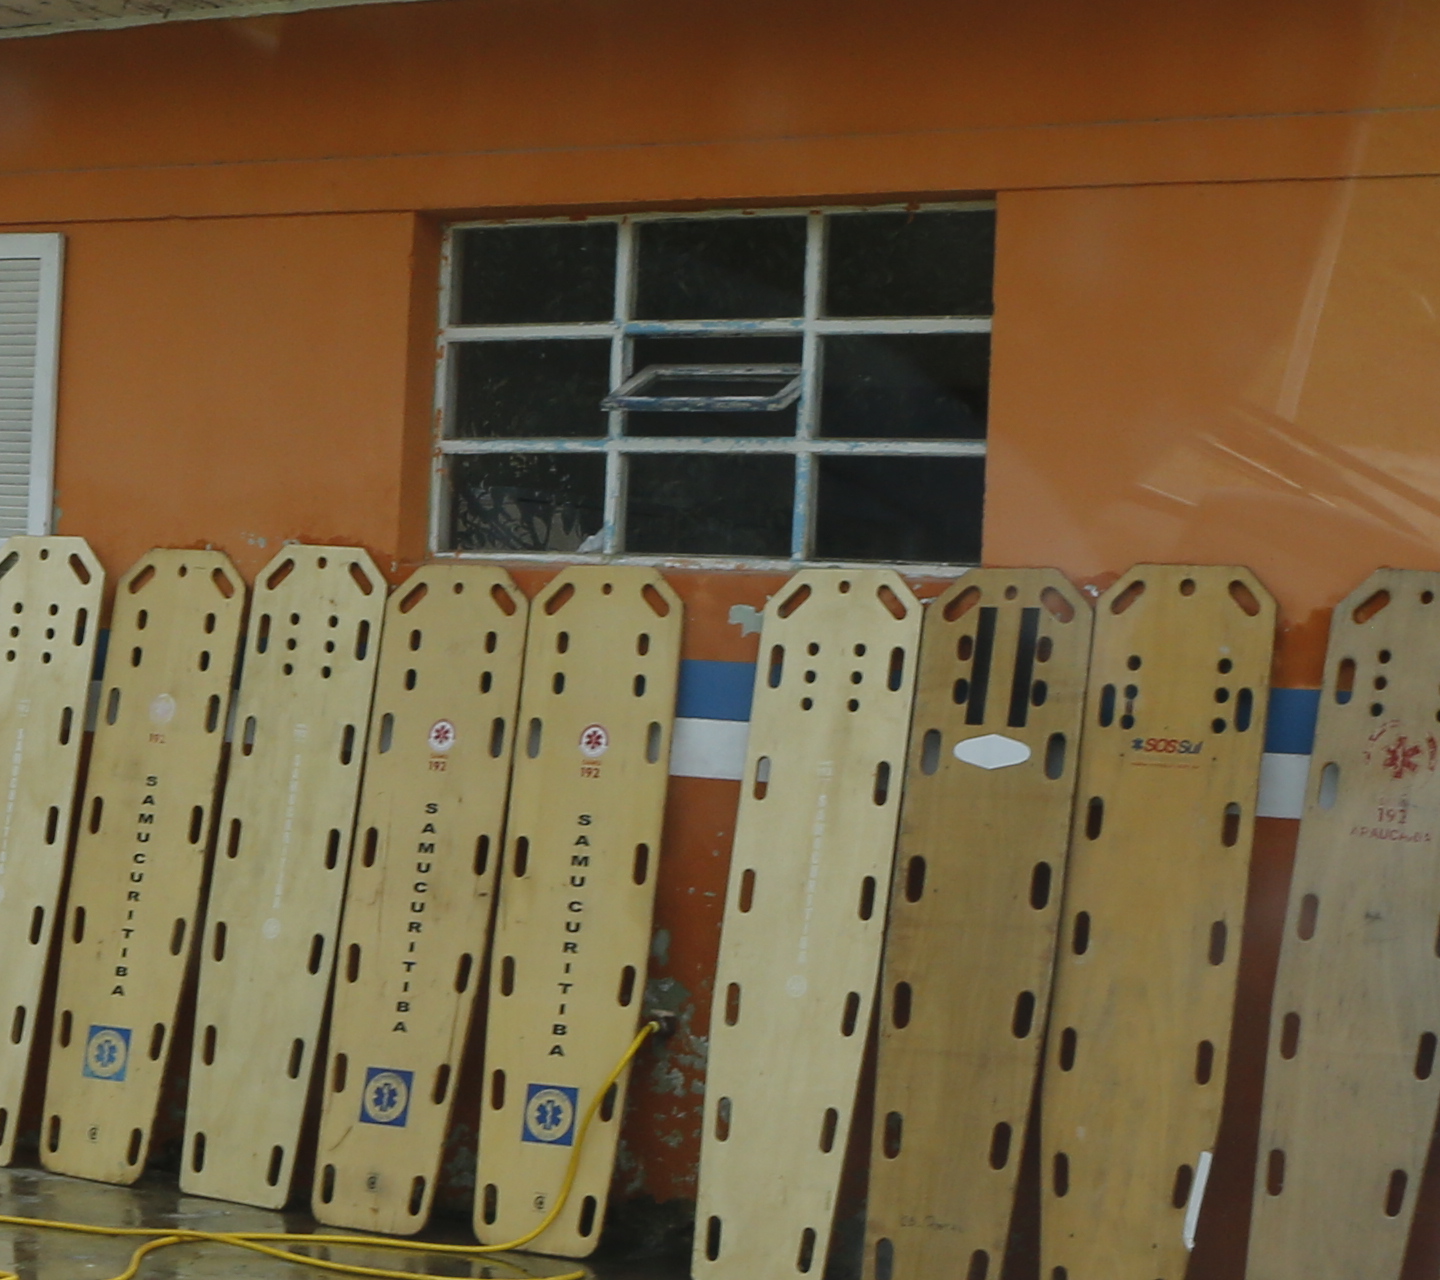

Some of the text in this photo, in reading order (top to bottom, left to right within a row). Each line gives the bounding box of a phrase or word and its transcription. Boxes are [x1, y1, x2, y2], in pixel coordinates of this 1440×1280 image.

[428, 760, 447, 772] 192
[579, 766, 601, 779] 192
[569, 814, 593, 888] SAMU
[111, 853, 146, 997] CURITIBA
[548, 900, 583, 1057] CURITIBA
